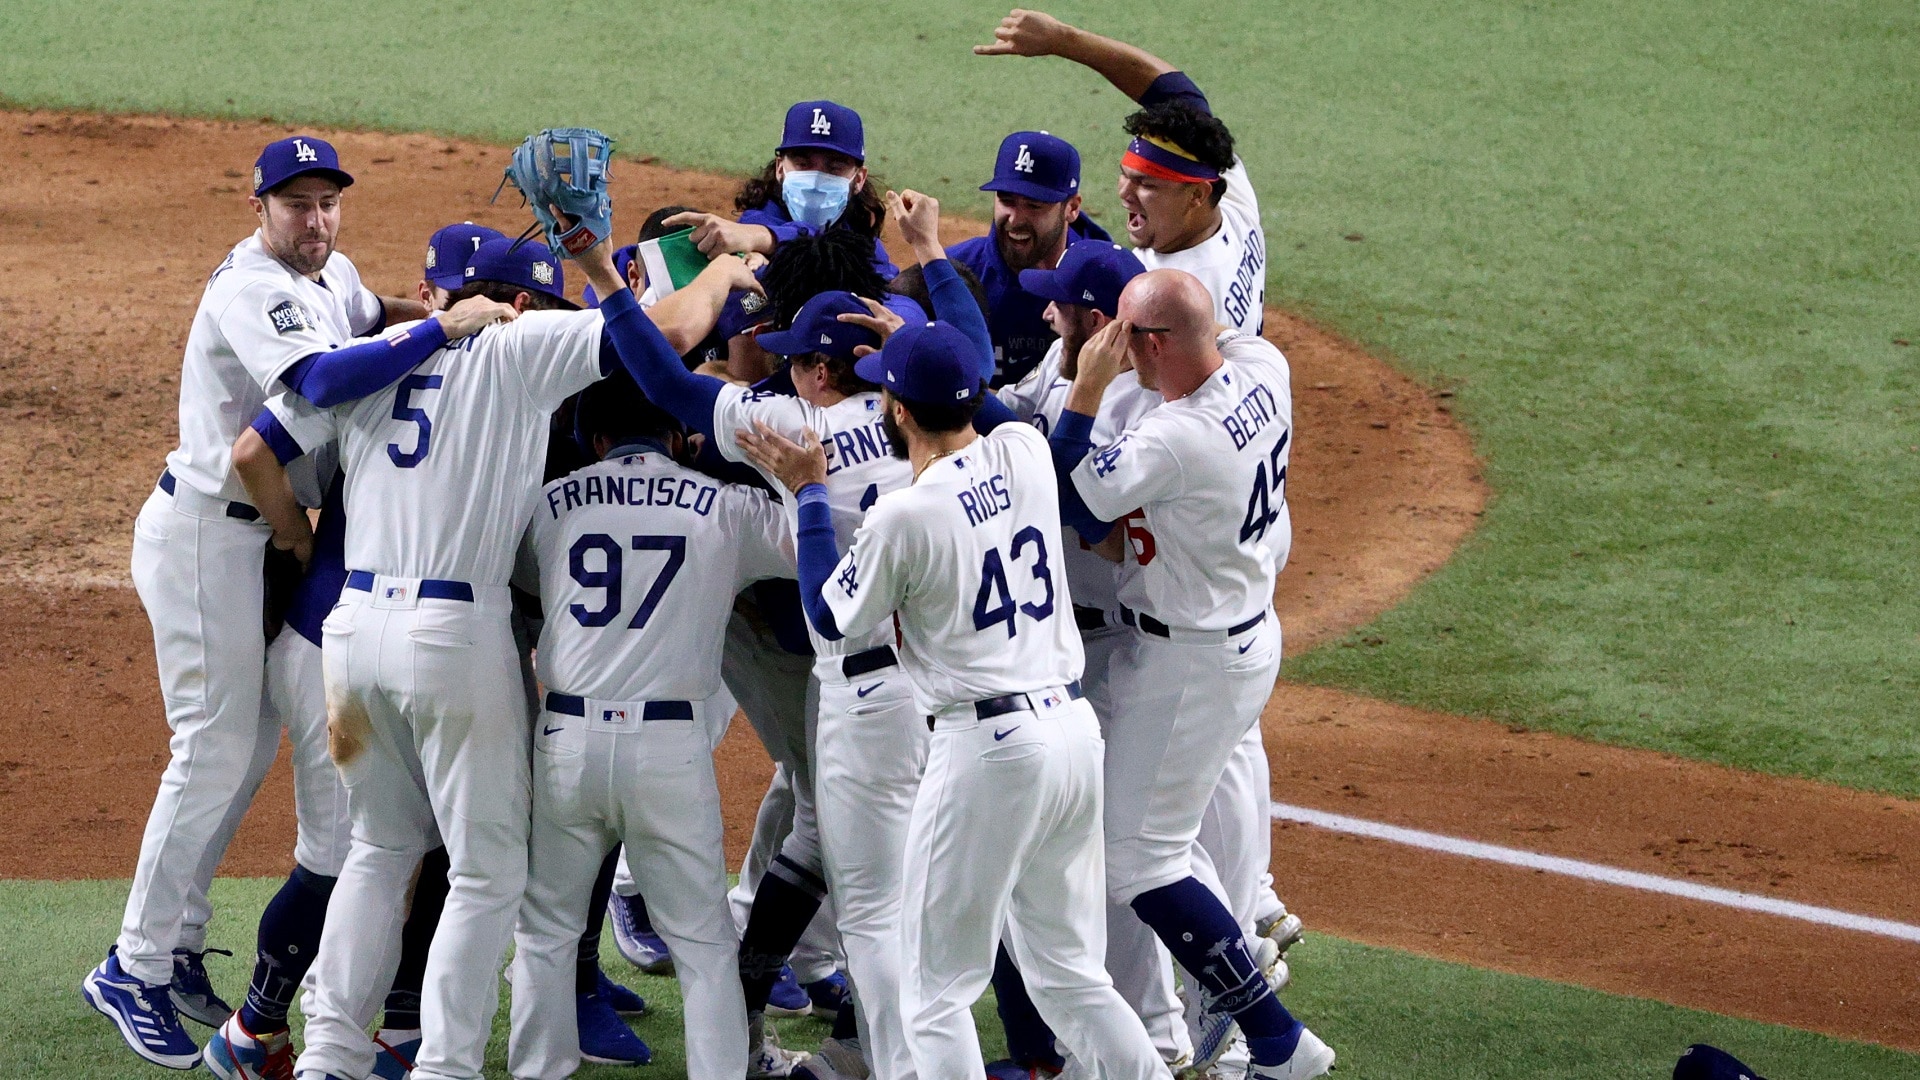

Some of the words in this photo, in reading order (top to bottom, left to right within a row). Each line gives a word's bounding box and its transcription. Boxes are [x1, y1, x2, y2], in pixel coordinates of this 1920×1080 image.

[293, 139, 318, 162] LA
[811, 108, 831, 136] LA
[1015, 145, 1034, 172] LA
[387, 374, 443, 468] 5
[1222, 383, 1278, 452] BEATY
[546, 475, 718, 521] FRANCISCO
[957, 474, 1012, 528] RÍOS
[1239, 429, 1289, 545] 45
[568, 533, 687, 630] 97
[972, 525, 1055, 640] 43
